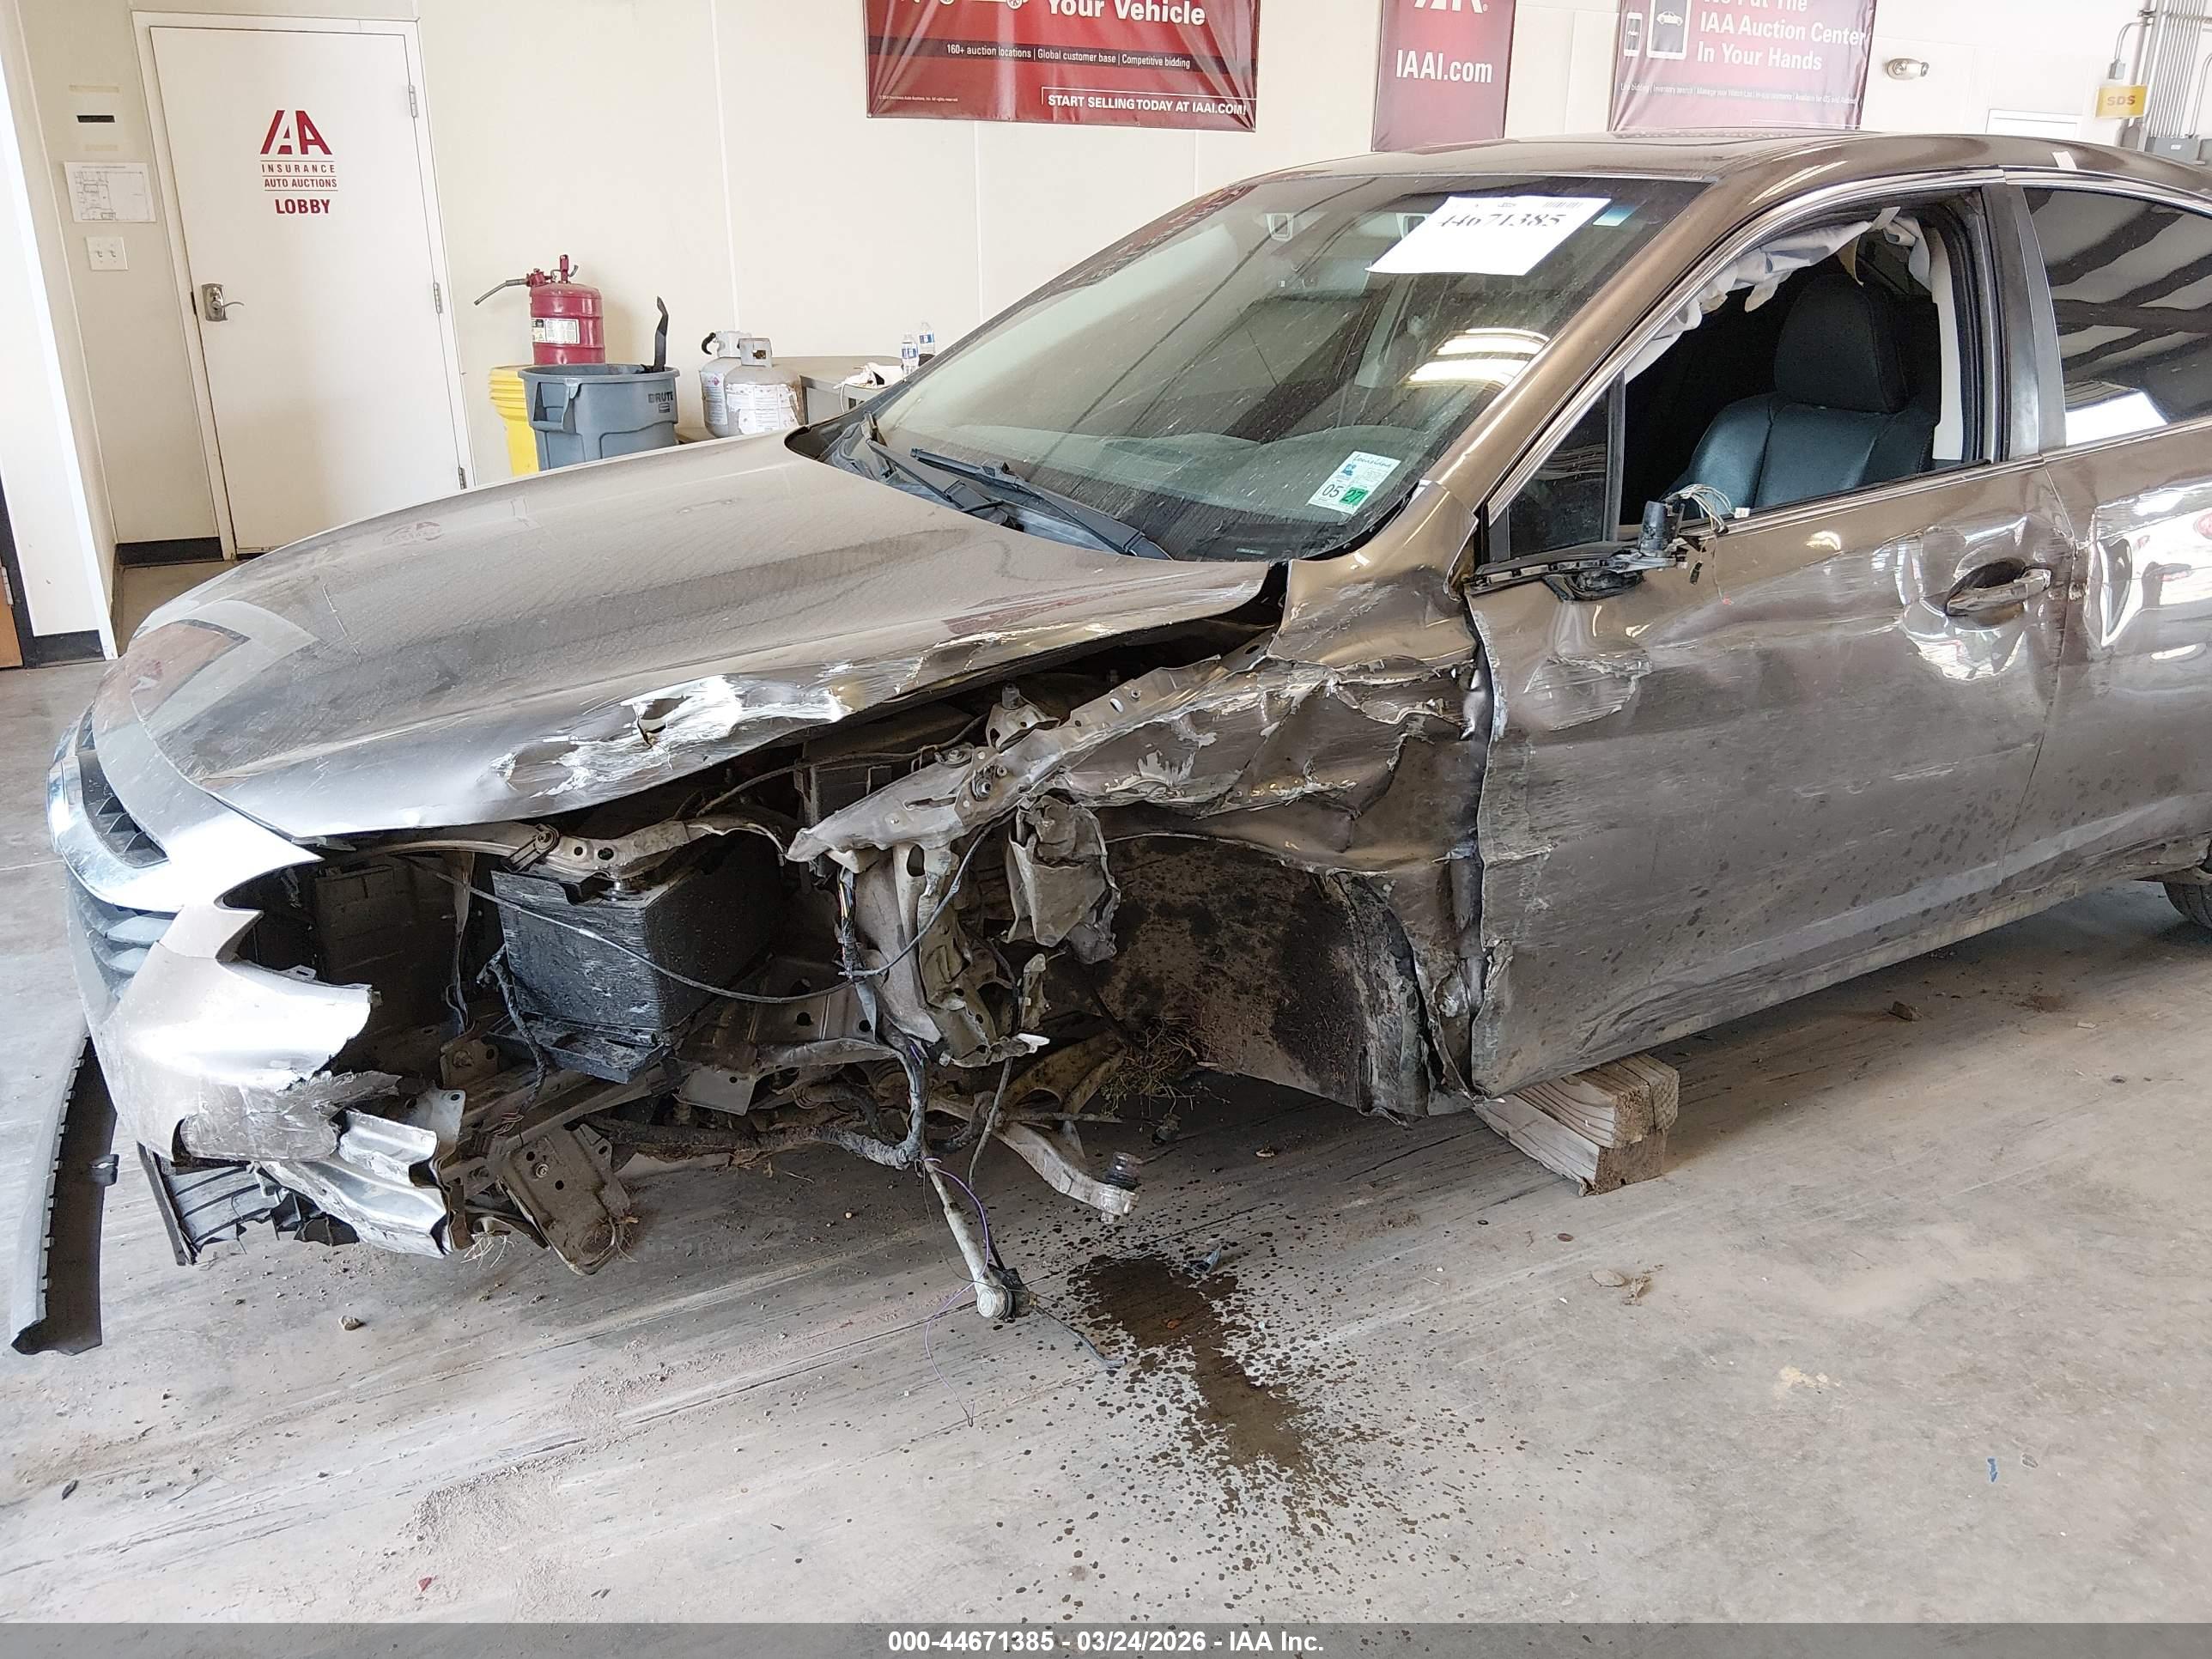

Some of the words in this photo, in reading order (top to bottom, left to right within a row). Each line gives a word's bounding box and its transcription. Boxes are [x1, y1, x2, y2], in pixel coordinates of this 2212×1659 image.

[1048, 0, 1104, 17] Your
[1114, 0, 1206, 26] Vehicle
[1700, 11, 1735, 33] IAA
[1738, 15, 1806, 40] Auction
[1811, 22, 1867, 46] Center
[946, 44, 964, 54] 160+
[967, 46, 996, 56] auction
[998, 46, 1031, 58] locations
[1037, 48, 1060, 60] Global
[1063, 52, 1097, 62] customer
[1098, 53, 1116, 64] base
[1121, 54, 1163, 67] Competitive
[1164, 58, 1190, 69] bidding
[1697, 41, 1716, 63] In
[1722, 43, 1764, 65] Your
[1767, 46, 1823, 70] Hands
[1395, 49, 1492, 83] IAAI.com
[1048, 94, 1085, 107] START
[1087, 96, 1135, 110] SELLING
[1137, 99, 1173, 112] TODAY
[1176, 101, 1190, 112] AT
[2107, 95, 2136, 106] SDS
[261, 164, 336, 173] INSURANCE
[264, 179, 289, 187] AUTO
[292, 179, 337, 188] AUCTIONS
[275, 198, 331, 214] LOBBY
[647, 391, 673, 404] BRUTE
[1322, 483, 1344, 498] 05
[1340, 489, 1367, 503] 27
